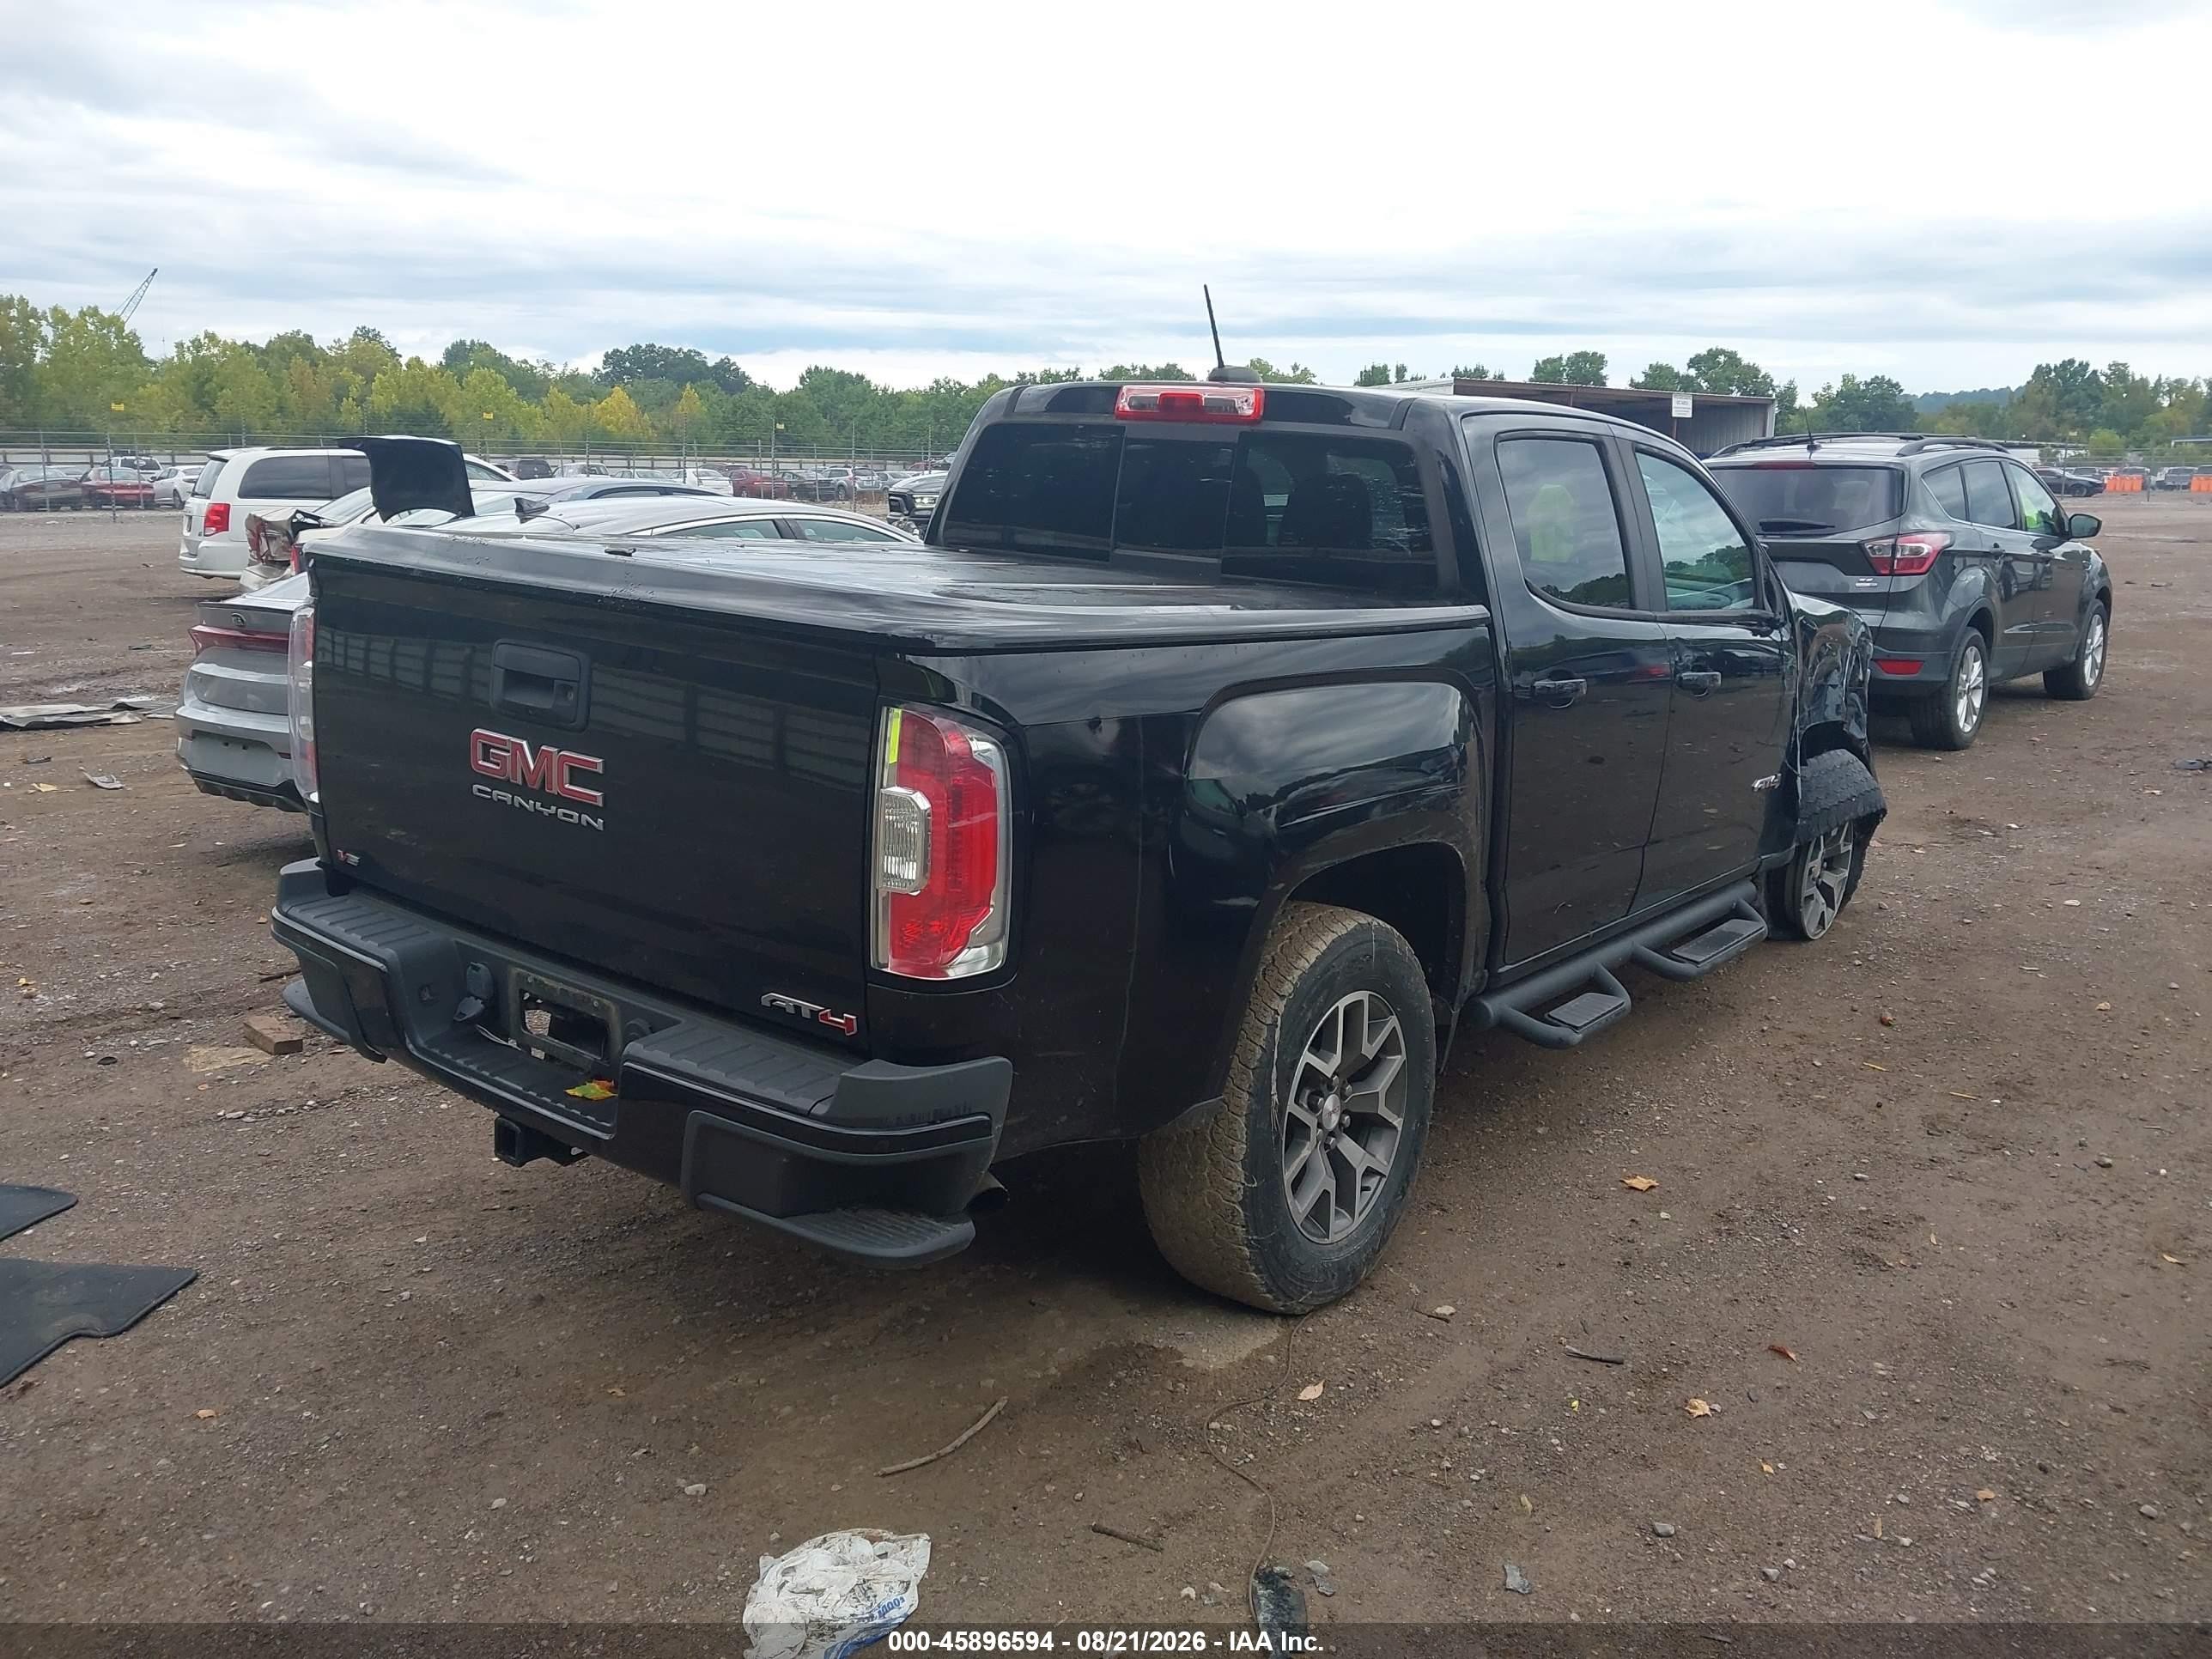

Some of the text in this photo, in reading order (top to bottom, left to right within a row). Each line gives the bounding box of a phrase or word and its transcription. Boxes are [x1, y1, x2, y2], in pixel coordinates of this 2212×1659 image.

[471, 728, 605, 807] GMC
[472, 784, 604, 831] CANYON
[761, 993, 858, 1036] AT4
